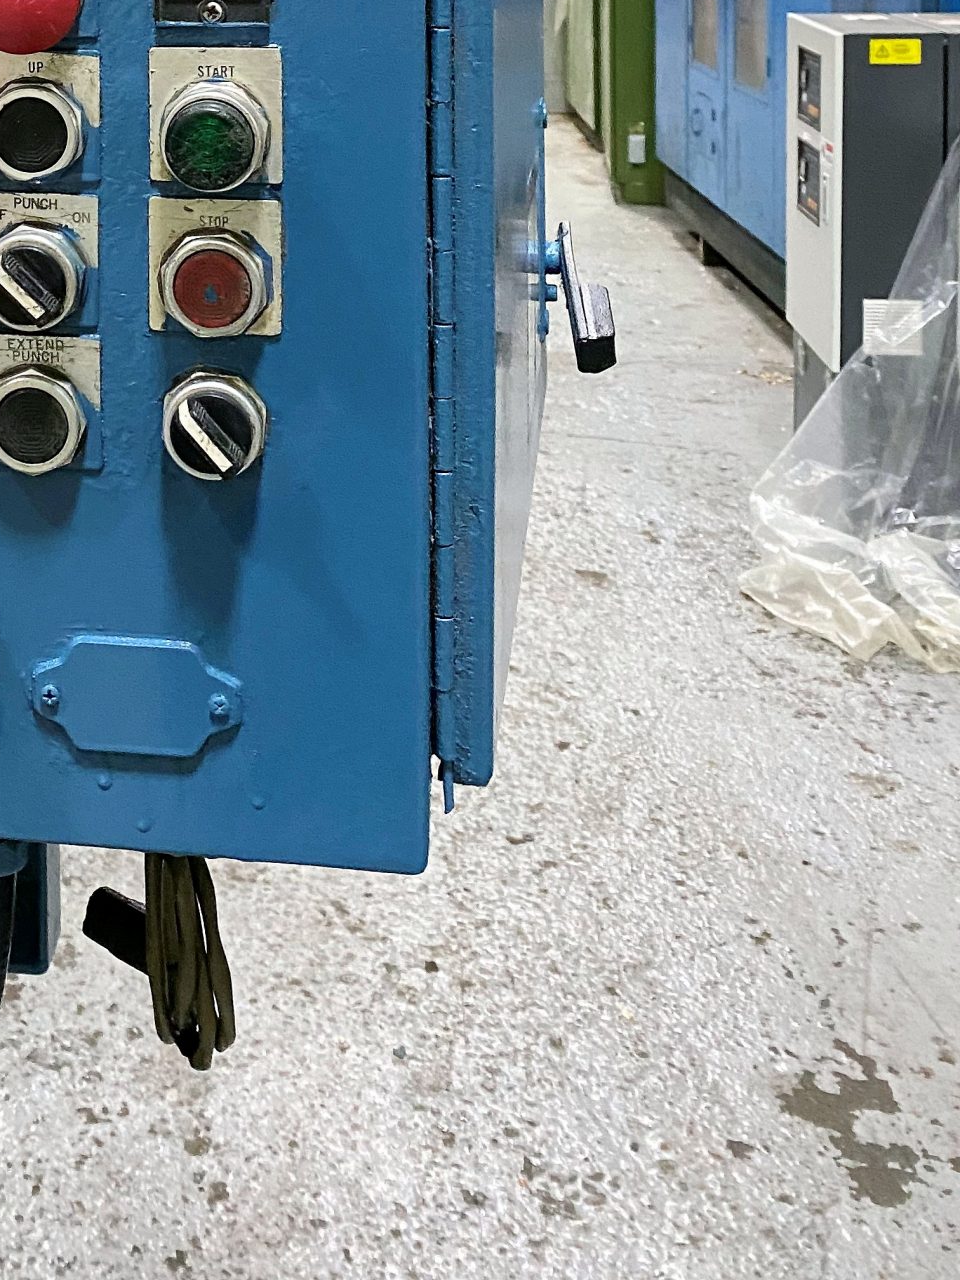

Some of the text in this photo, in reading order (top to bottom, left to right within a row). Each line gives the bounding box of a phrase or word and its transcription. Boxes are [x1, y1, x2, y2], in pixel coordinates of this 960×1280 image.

[27, 60, 45, 74] UP
[197, 64, 236, 79] START
[13, 197, 58, 210] PUNCH
[72, 211, 91, 223] ON
[199, 216, 229, 227] STOP
[7, 338, 64, 351] EXTEND
[12, 351, 60, 363] PUNCH
